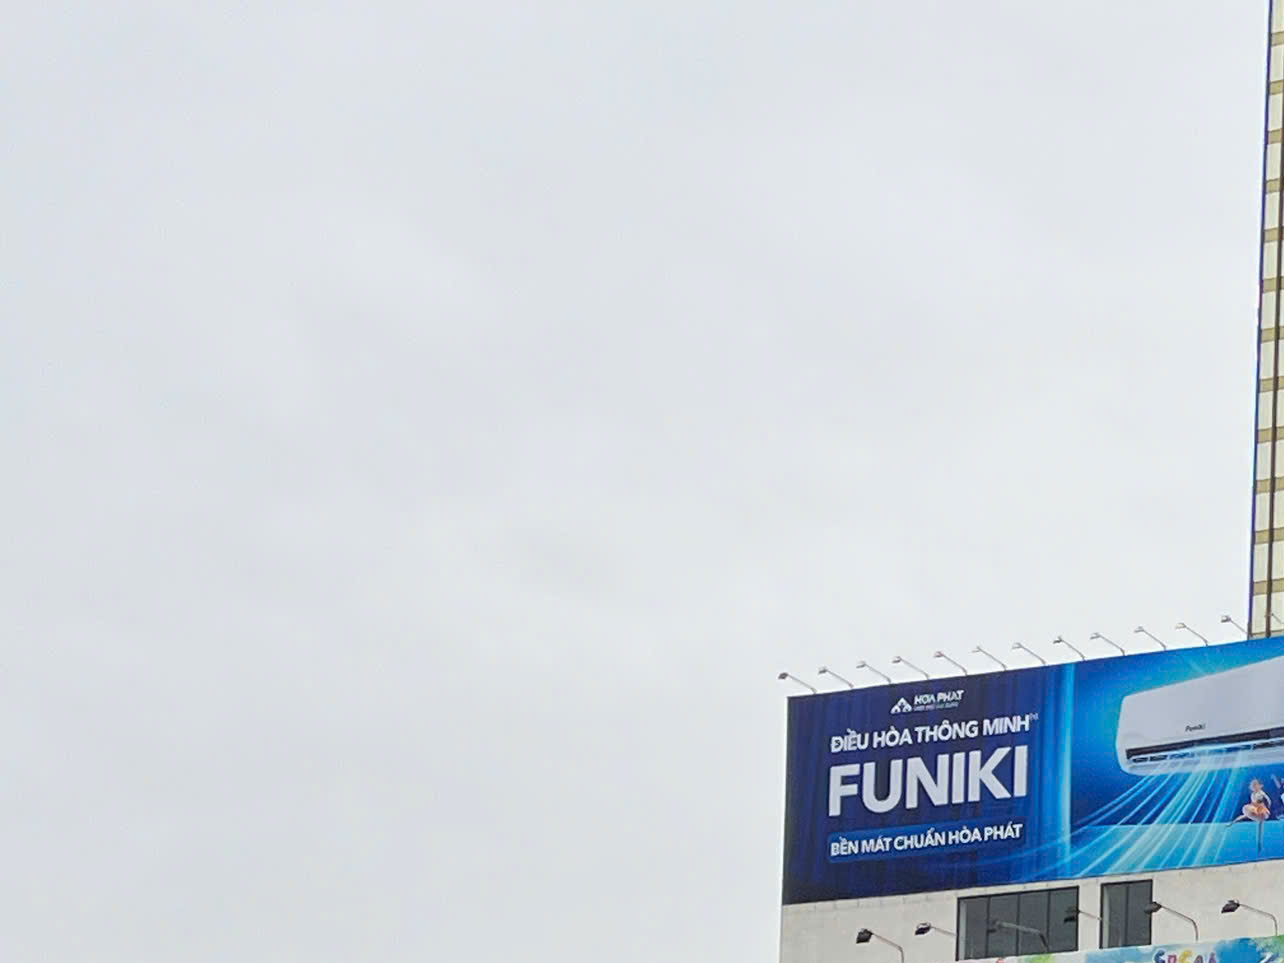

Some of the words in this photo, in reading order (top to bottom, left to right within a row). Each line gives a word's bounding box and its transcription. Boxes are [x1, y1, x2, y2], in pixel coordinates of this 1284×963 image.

[830, 728, 870, 754] ĐIỀU
[872, 725, 913, 748] HÒA
[914, 720, 979, 744] THÔNG
[982, 714, 1031, 736] MINH
[828, 745, 1029, 817] FUNIKI
[830, 835, 860, 857] BỀN
[861, 835, 893, 853] MÁT
[893, 827, 946, 850] CHUẨN
[947, 825, 982, 846] HÒA
[983, 820, 1024, 841] PHÁT
